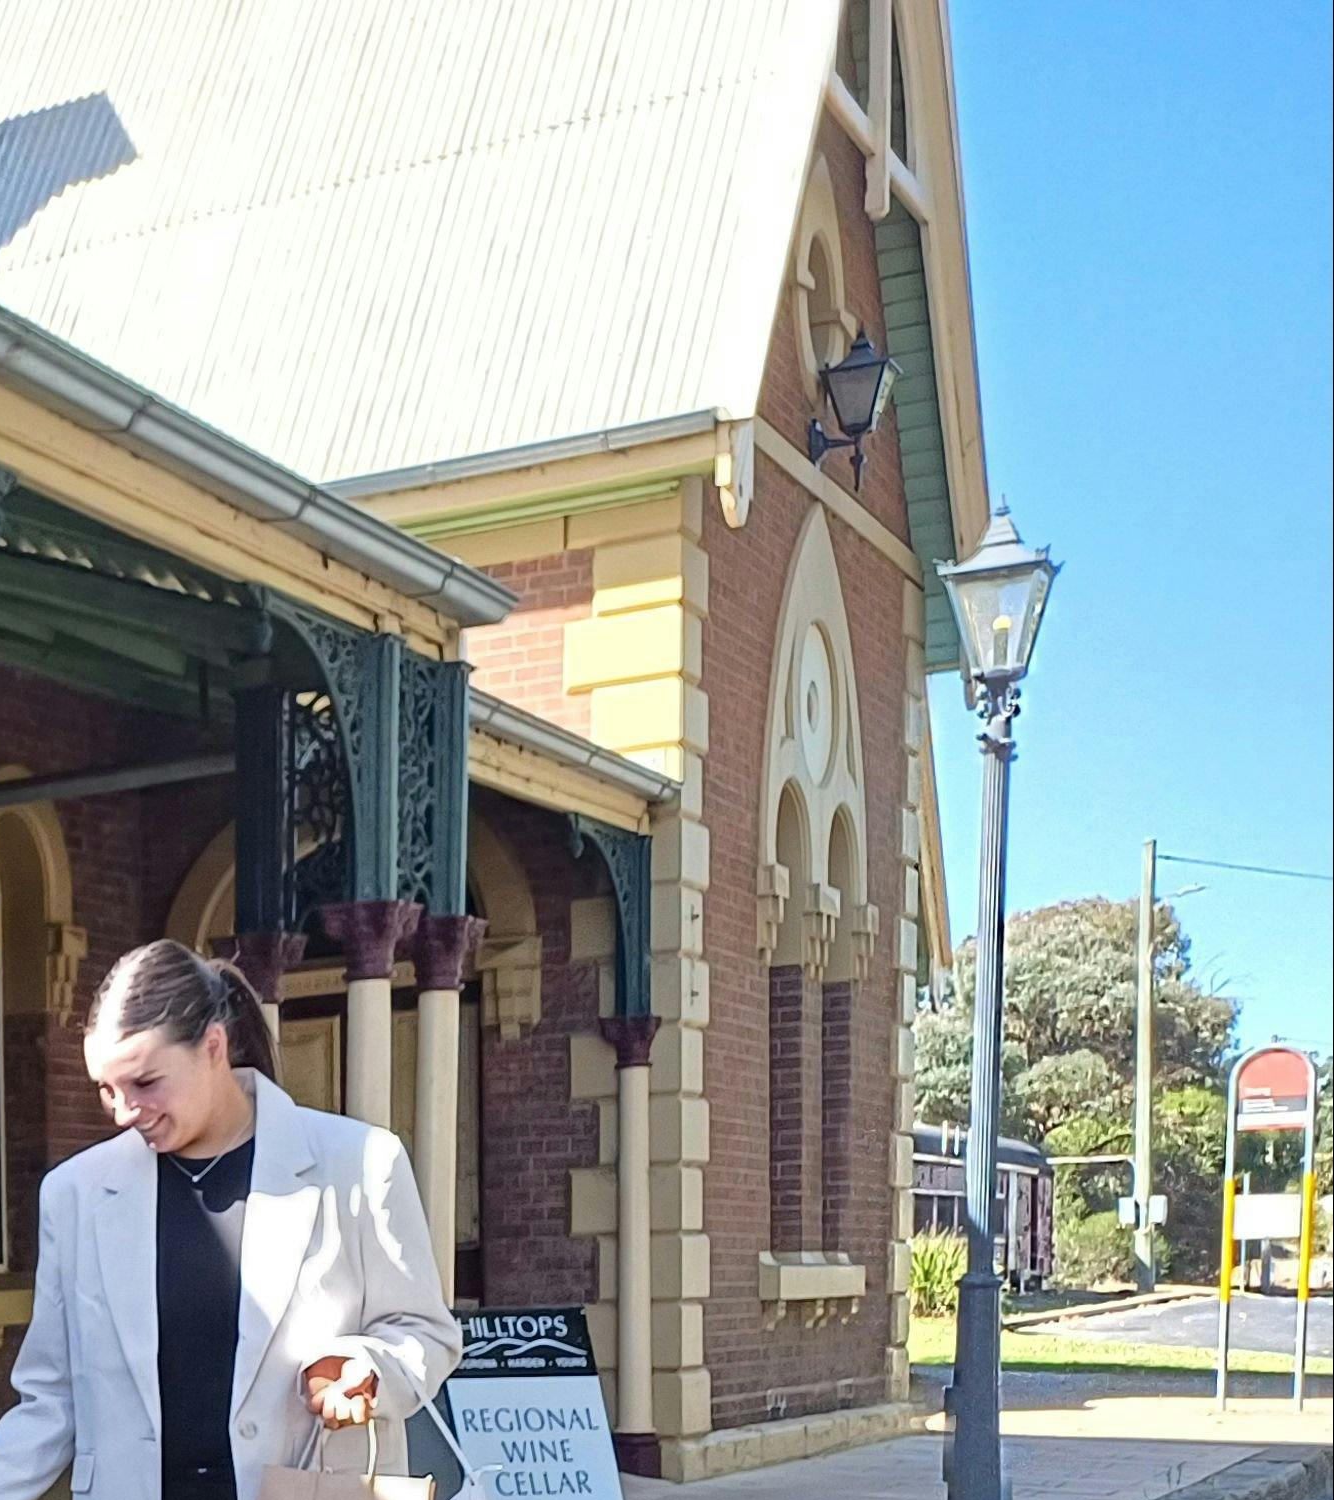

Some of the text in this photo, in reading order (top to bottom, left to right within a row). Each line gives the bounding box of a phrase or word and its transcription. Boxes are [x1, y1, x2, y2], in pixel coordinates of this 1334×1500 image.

[454, 1315, 569, 1339] HILLTOPS
[461, 1407, 600, 1433] REGIONAL
[501, 1438, 574, 1463] WINE
[495, 1470, 592, 1497] CELLAR
